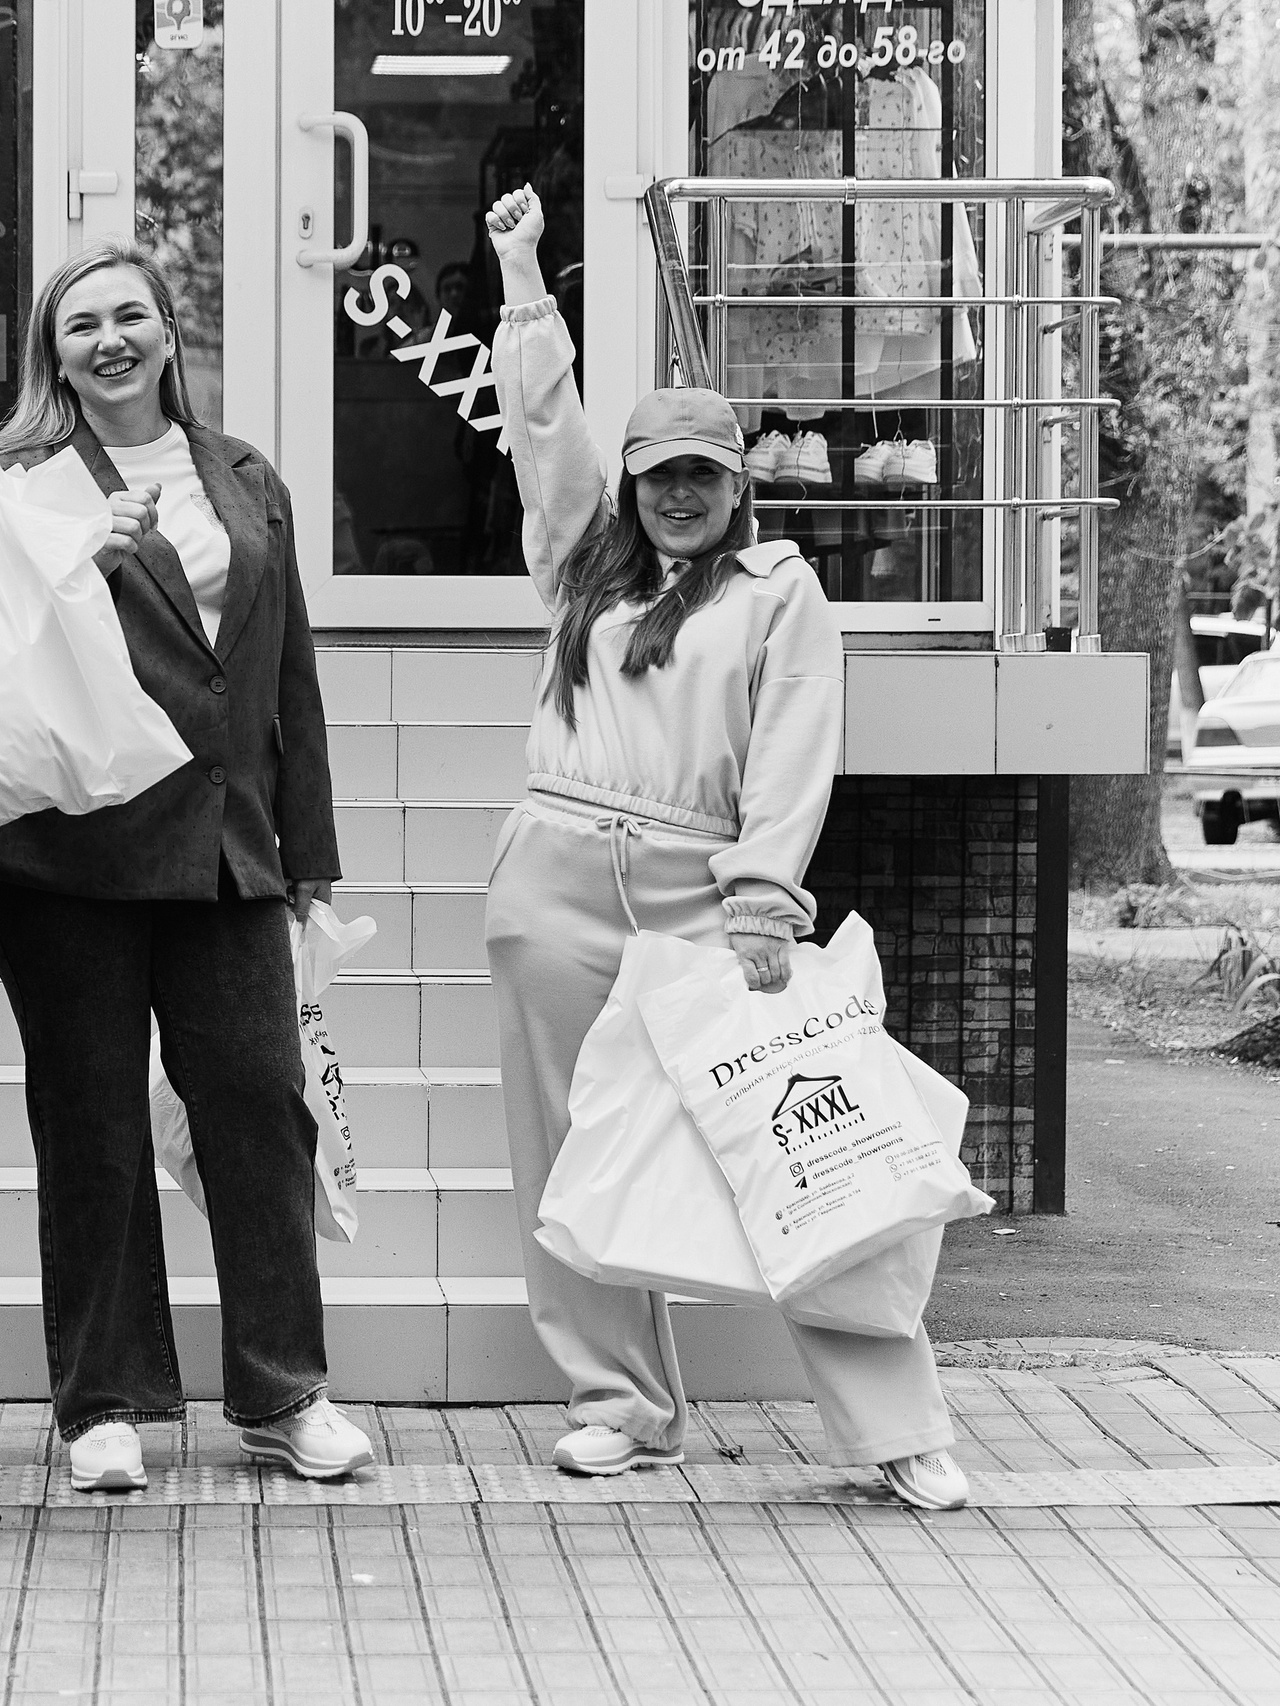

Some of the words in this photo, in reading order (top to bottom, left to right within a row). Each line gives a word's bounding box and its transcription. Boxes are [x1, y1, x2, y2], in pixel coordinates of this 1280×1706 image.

[696, 46, 746, 72] от
[758, 28, 806, 69] 42
[817, 34, 858, 68] до
[708, 994, 878, 1090] DressCode
[725, 1076, 765, 1107] СТИЛЬНАЯ
[765, 1054, 804, 1078] ЖЕНСКАЯ
[805, 1038, 843, 1057] ОДЕЖДА
[844, 1033, 855, 1044] ОТ
[806, 1121, 902, 1167] dresscode_showrooms2
[812, 1136, 904, 1180] dresscode_showrooms
